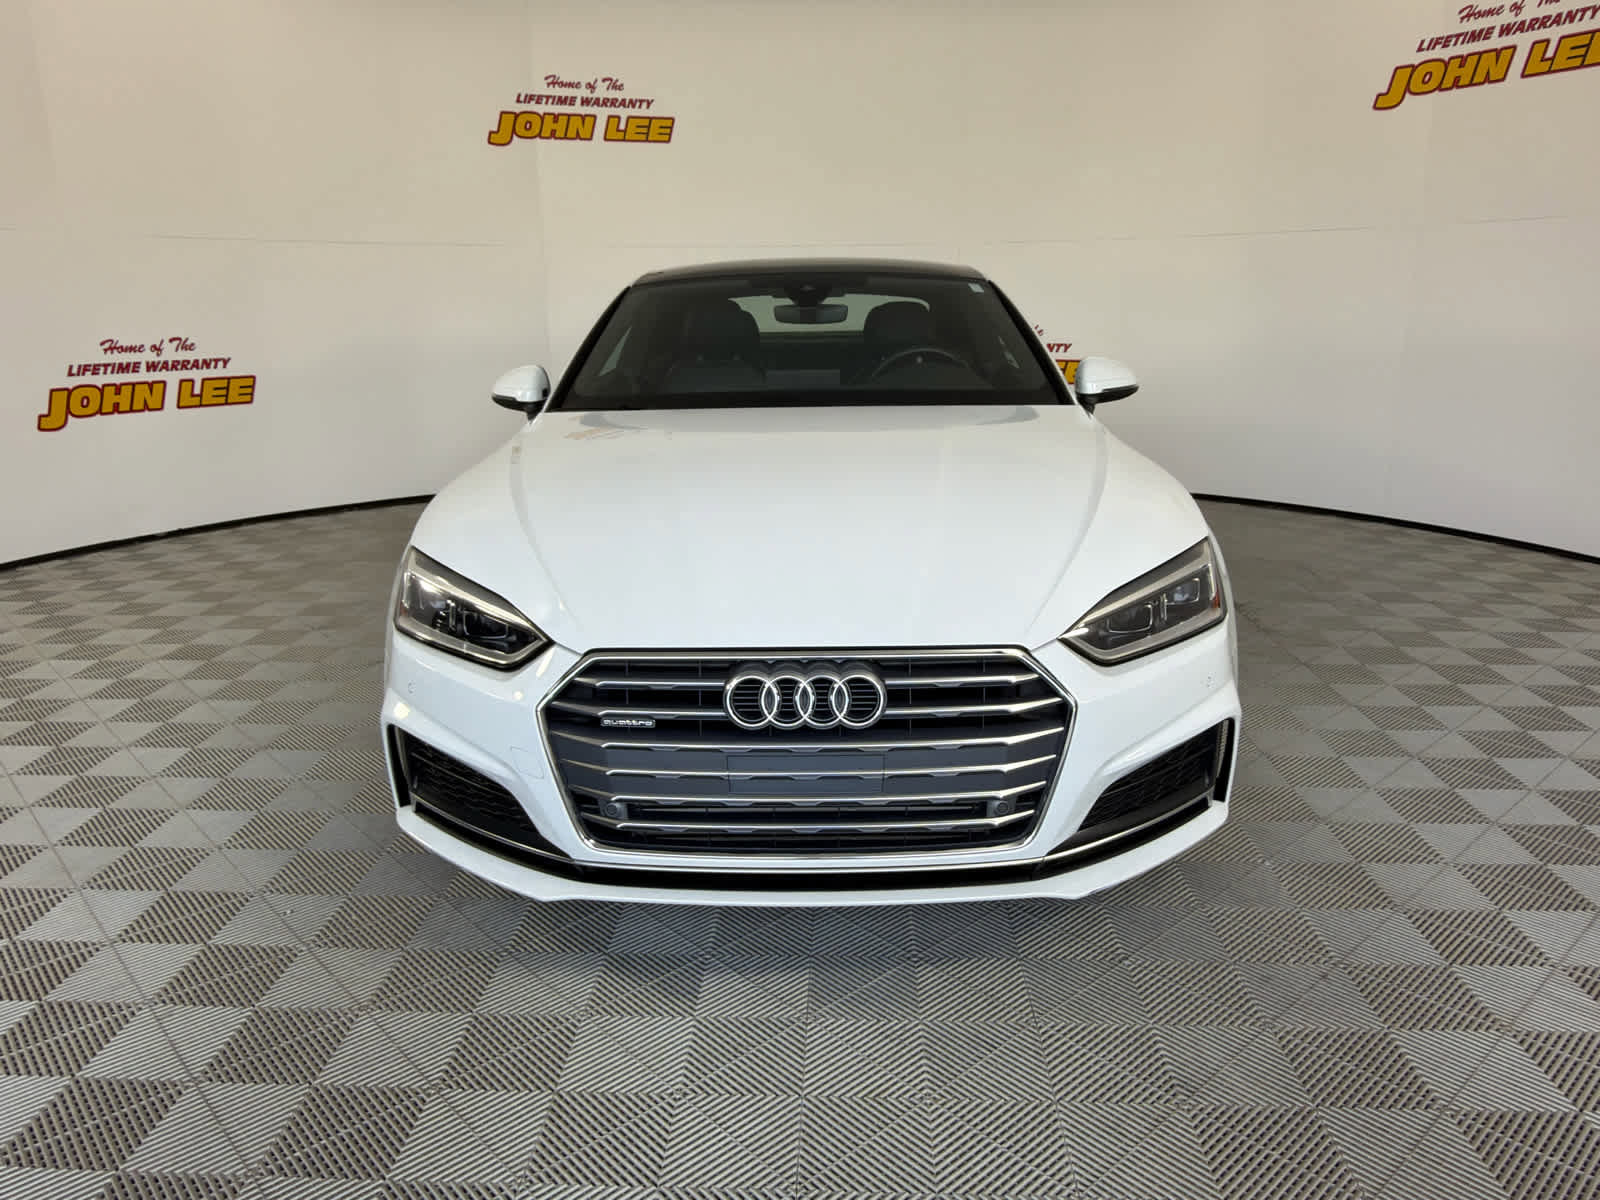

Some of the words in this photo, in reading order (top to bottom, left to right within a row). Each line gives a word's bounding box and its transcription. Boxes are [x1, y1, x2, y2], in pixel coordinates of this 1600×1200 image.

[1458, 4, 1505, 24] Home
[1416, 26, 1496, 53] LIFETIME
[1498, 4, 1600, 38] WARRANTY
[544, 74, 582, 90] Home
[585, 78, 598, 94] of
[601, 77, 625, 91] The
[1372, 44, 1517, 111] JOHN
[515, 93, 577, 107] LIFETIME
[580, 96, 655, 109] WARRANTY
[488, 111, 597, 147] JOHN
[603, 115, 675, 143] LEE
[100, 338, 145, 355] Home
[149, 339, 165, 357] of
[169, 336, 197, 352] The
[67, 361, 142, 377] LIFETIME
[145, 357, 231, 373] WARRANTY
[37, 380, 166, 432] JOHN
[176, 375, 256, 409] LEE
